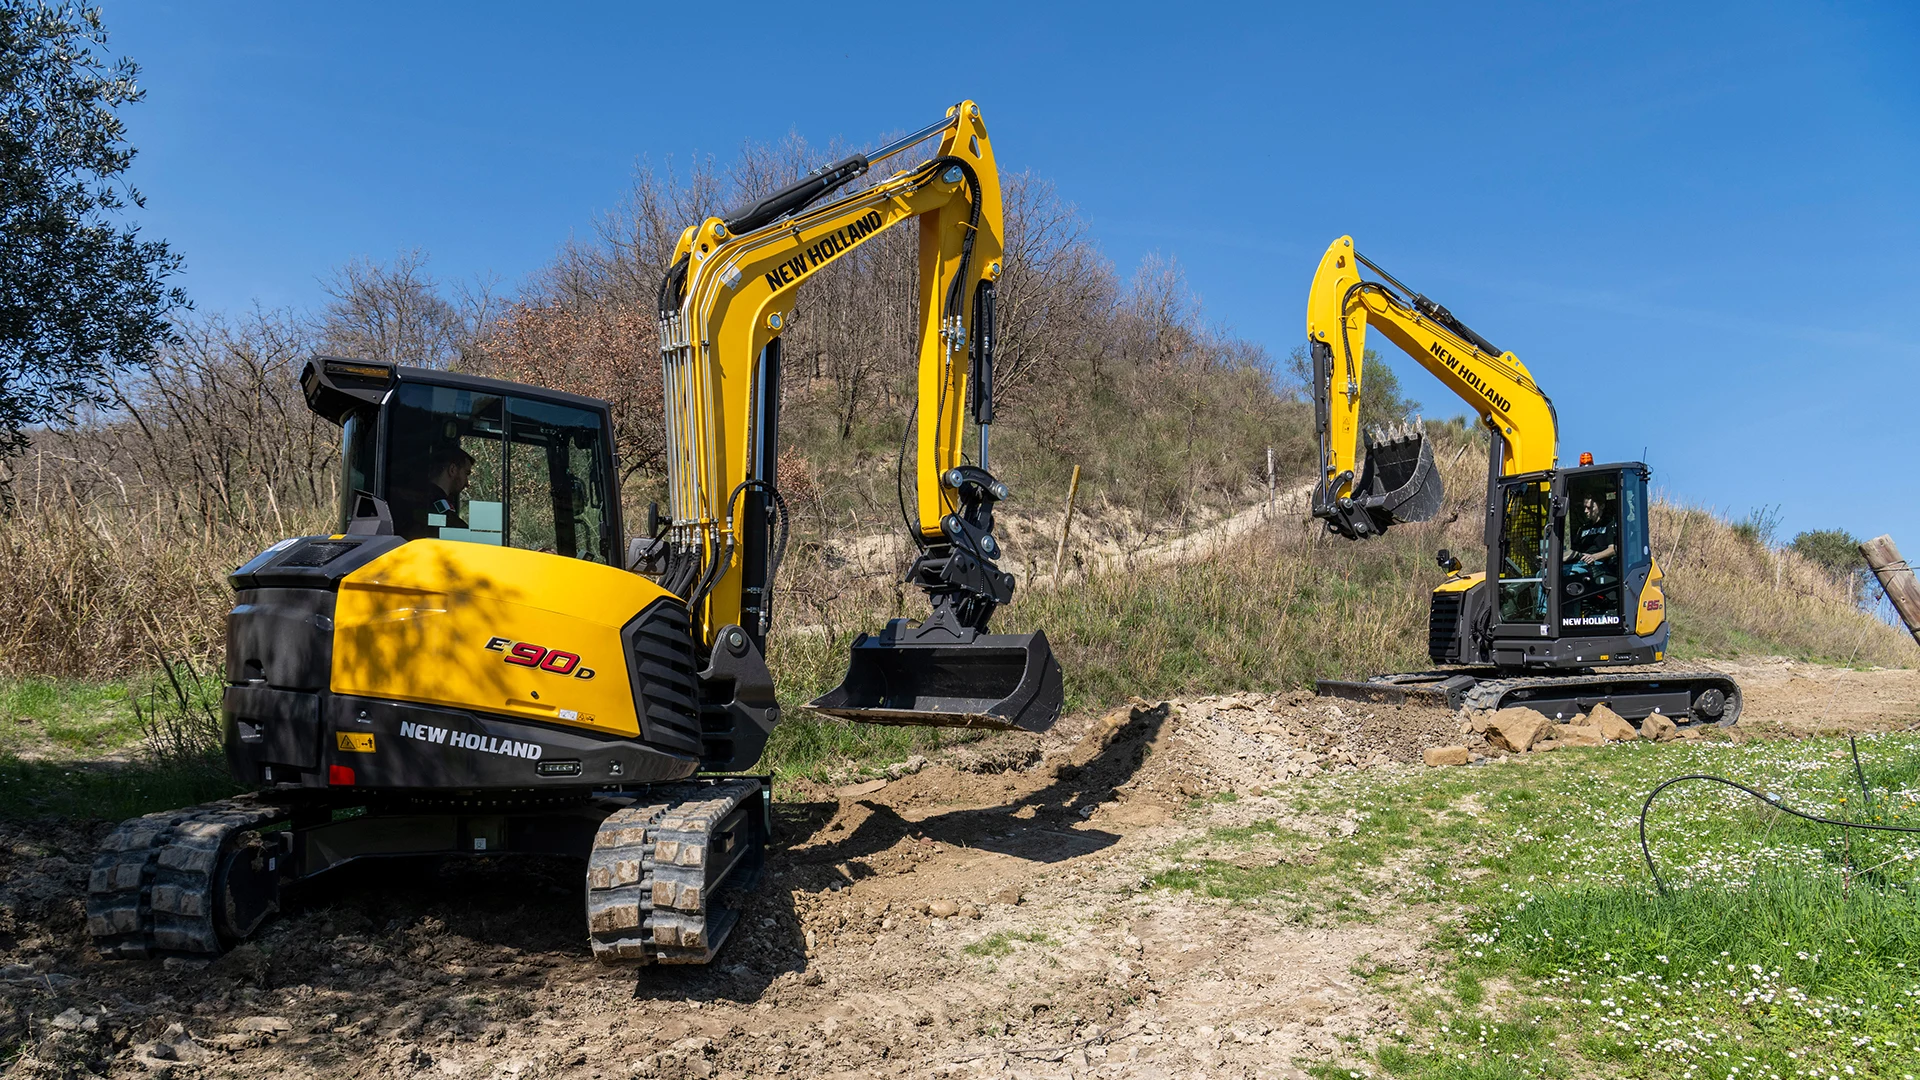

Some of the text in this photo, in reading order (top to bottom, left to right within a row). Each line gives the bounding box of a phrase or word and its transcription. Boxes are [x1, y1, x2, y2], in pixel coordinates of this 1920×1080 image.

[765, 210, 882, 292] NEW HOLLAND
[1430, 341, 1511, 413] NEW HOLLAND
[1562, 616, 1620, 626] NEW HOLLAND
[400, 720, 542, 760] NEW HOLLAND
